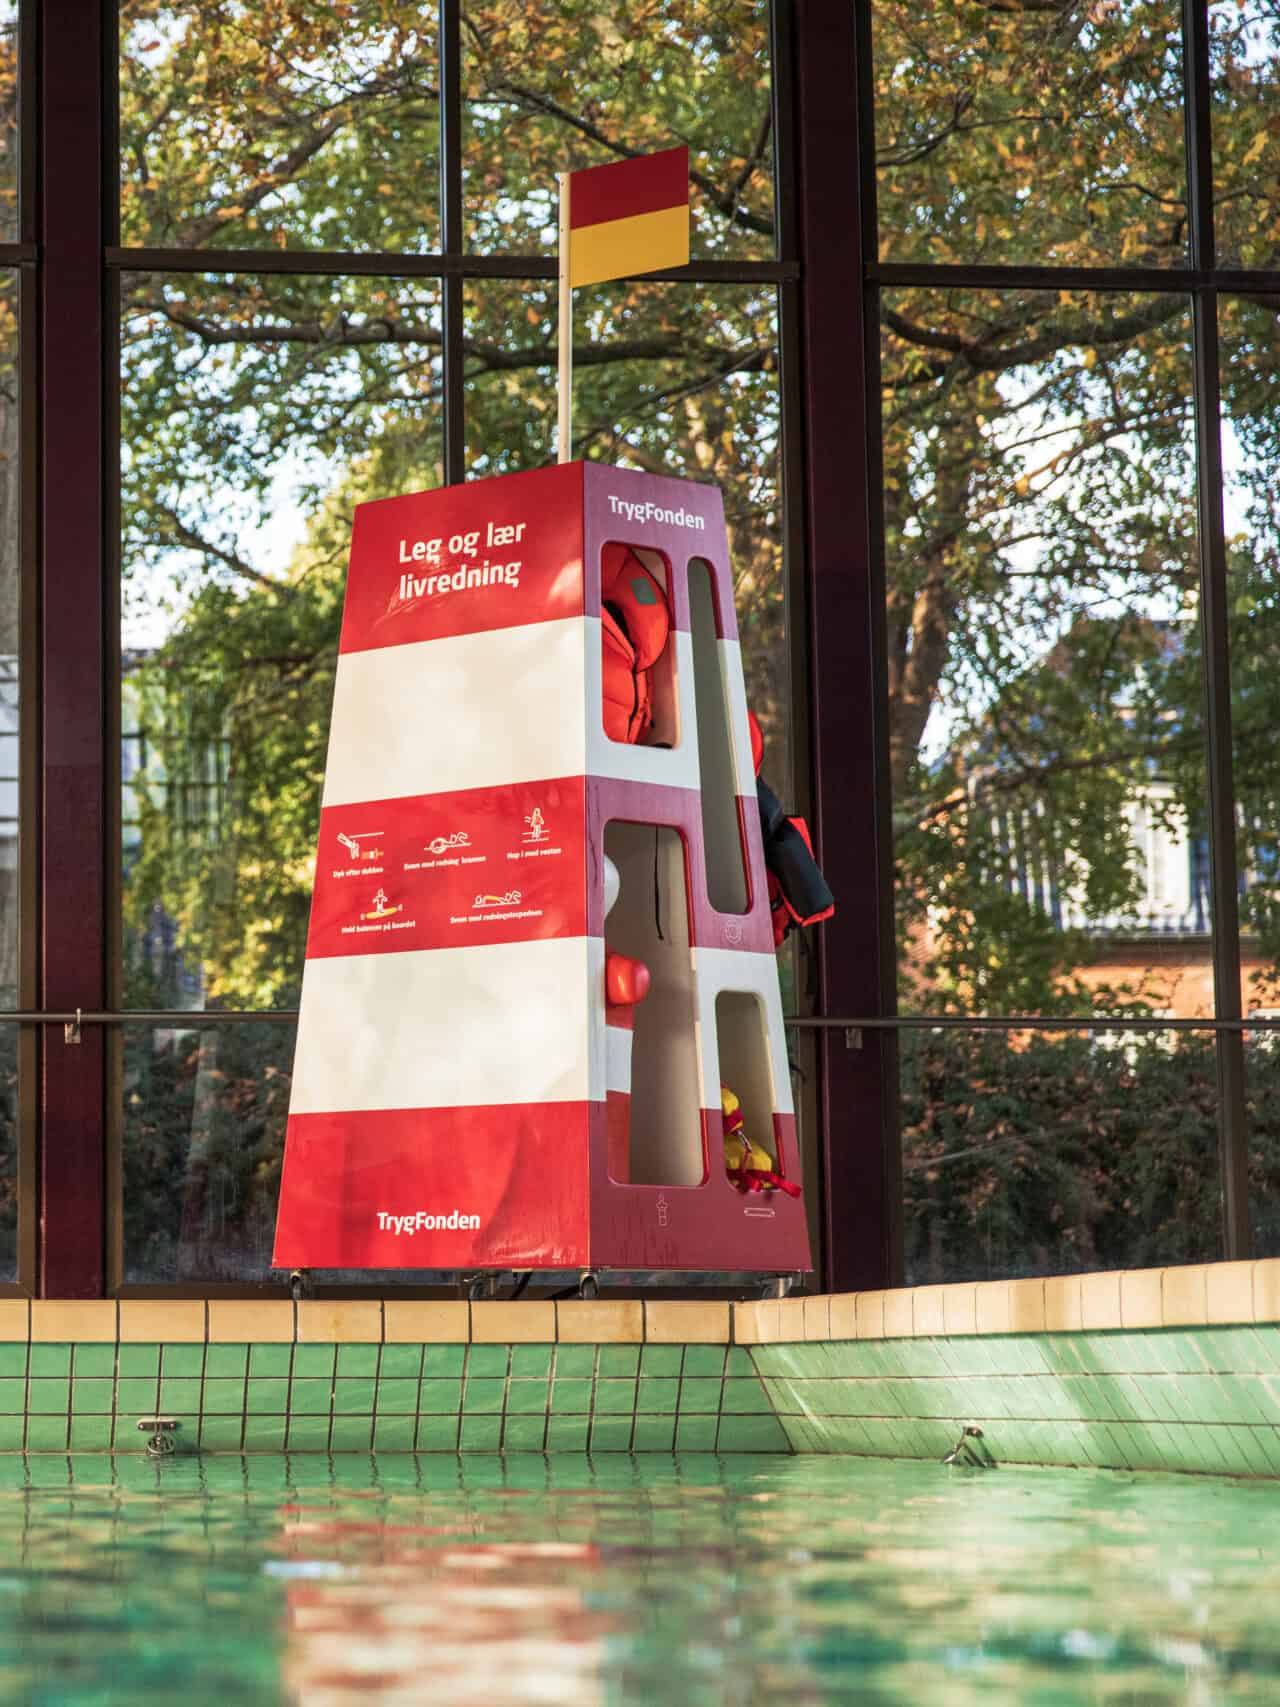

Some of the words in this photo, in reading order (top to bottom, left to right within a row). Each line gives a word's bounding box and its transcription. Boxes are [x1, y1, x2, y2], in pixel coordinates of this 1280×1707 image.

[608, 495, 705, 530] TrygFonden
[399, 538, 442, 564] Leg
[448, 531, 480, 558] og
[486, 522, 527, 547] lær
[399, 560, 522, 600] livredning
[376, 1209, 481, 1236] TrygFonden
